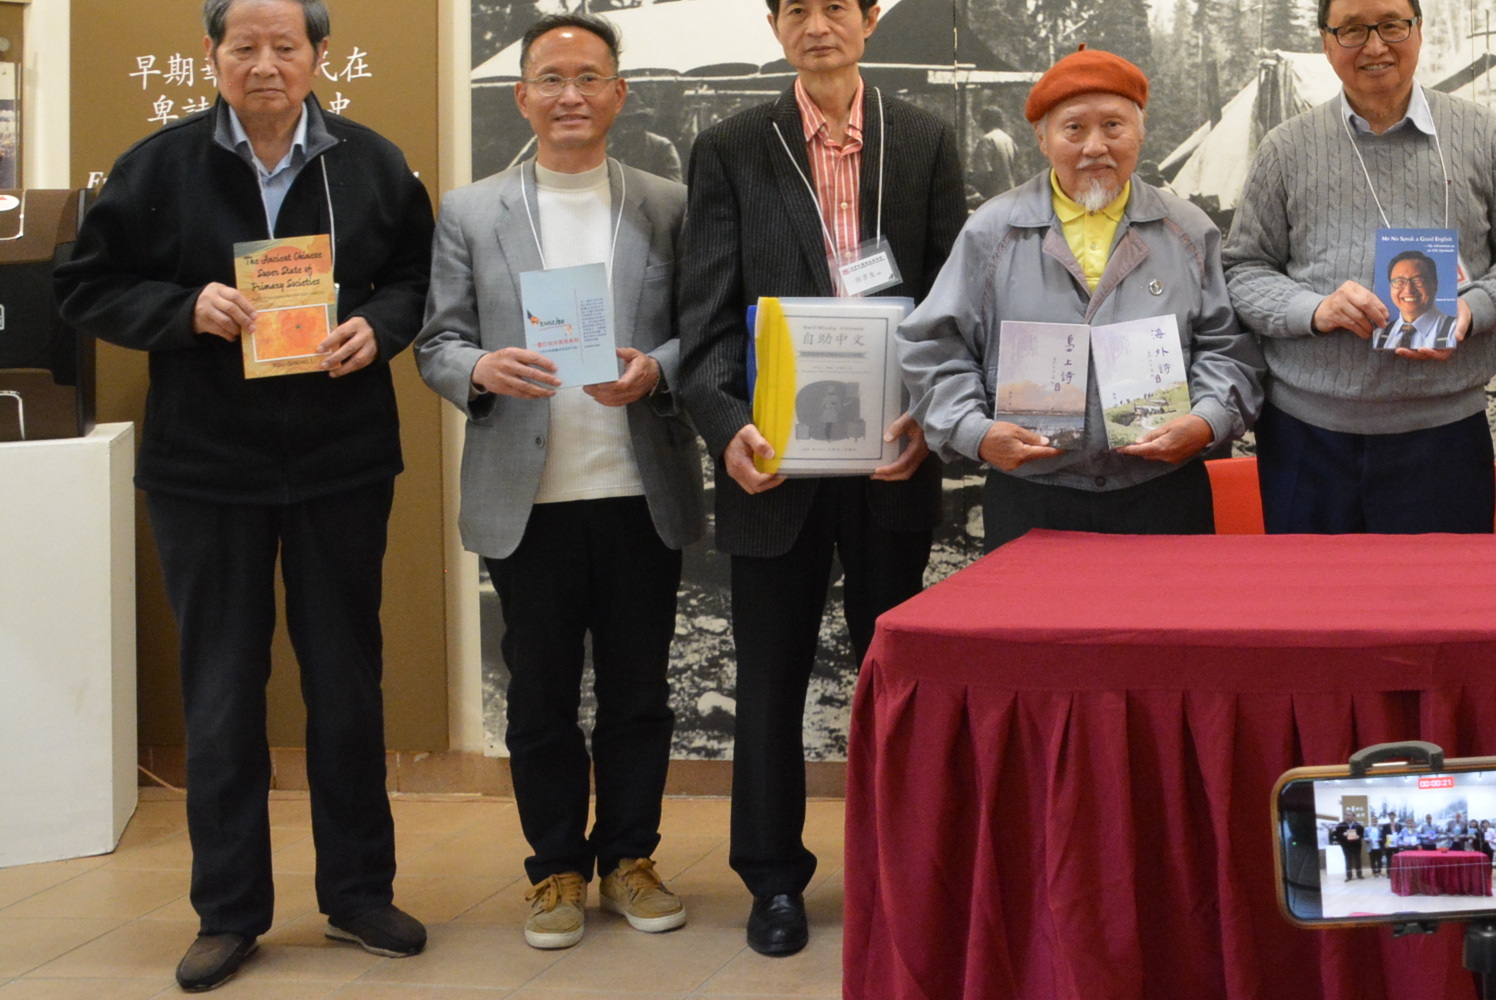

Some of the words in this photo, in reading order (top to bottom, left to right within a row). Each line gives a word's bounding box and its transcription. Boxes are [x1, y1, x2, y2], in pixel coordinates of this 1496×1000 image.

[243, 256, 259, 266] The
[260, 254, 292, 265] Ancient
[293, 251, 323, 261] Chinese
[257, 268, 279, 278] Super
[281, 266, 302, 276] State
[303, 264, 314, 278] of
[251, 281, 285, 293] Primary
[286, 278, 321, 289] Societies
[803, 332, 866, 346] 自助中文
